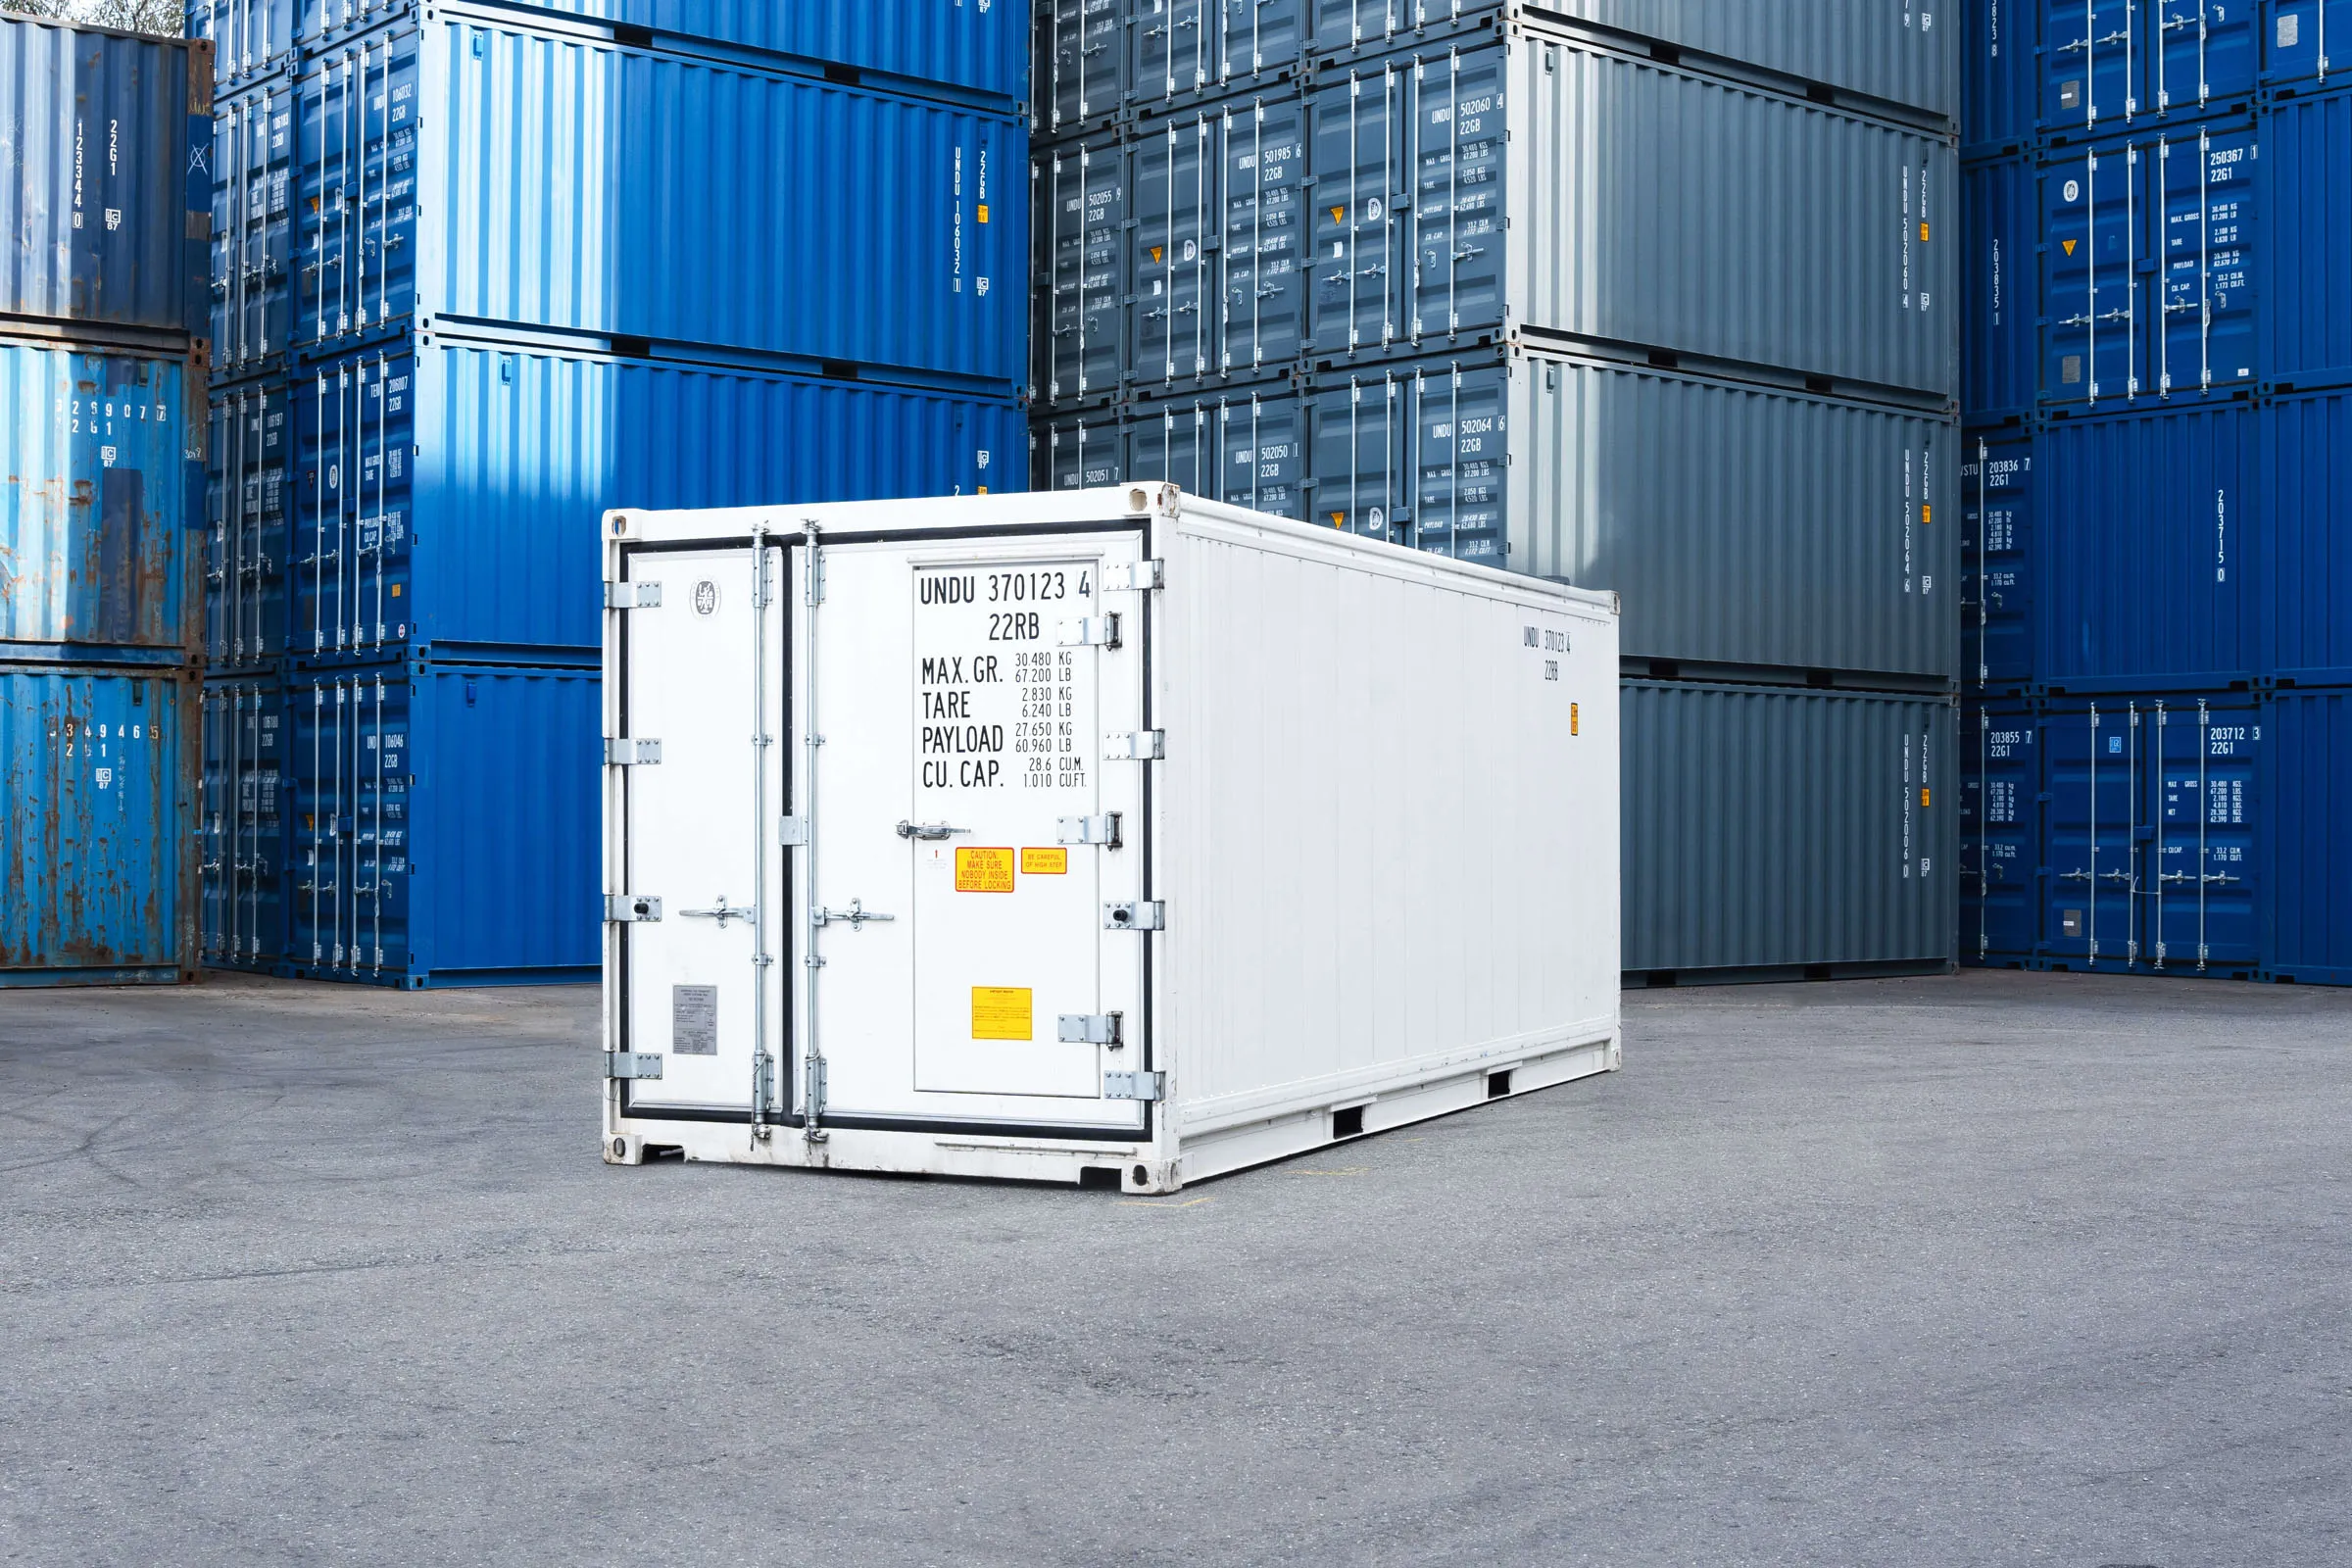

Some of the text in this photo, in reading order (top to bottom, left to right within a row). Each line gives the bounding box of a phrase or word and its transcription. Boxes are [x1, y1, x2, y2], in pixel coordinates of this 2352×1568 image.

[1432, 107, 1450, 123] UNDU
[1460, 97, 1491, 117] 502060
[1459, 119, 1481, 135] 22GB
[1239, 155, 1255, 171] UNDU
[1264, 146, 1291, 165] 501985
[2210, 148, 2243, 166] 250367
[1264, 166, 1283, 181] 22GB
[2211, 167, 2232, 182] 22G1
[1089, 190, 1112, 206] 502055
[1088, 208, 1104, 222] 22GB
[107, 222, 118, 231] 87
[2173, 260, 2194, 270] PAYLOAD
[1433, 416, 1505, 439] UNDU 502064 6
[1460, 438, 1482, 453] 22GB
[1235, 450, 1252, 464] UNDU
[1261, 445, 1288, 460] 502050
[1260, 464, 1279, 477] 22GB
[1988, 460, 2019, 473] 203836
[1086, 468, 1108, 483] 502051
[1989, 473, 2009, 486] 22G1
[920, 570, 1091, 605] UNDU 370123 4
[989, 612, 1040, 640] 22RB
[1524, 626, 1540, 649] UNDU
[1544, 629, 1565, 653] 370123
[1015, 652, 1072, 666] 30.480 KG
[1015, 668, 1072, 682] 67.200 LB
[1022, 687, 1072, 702] 2.830 KG
[922, 691, 971, 718] TARE
[1022, 703, 1072, 717] 6.240 LB
[1015, 722, 1072, 737] 27.650 KG
[2210, 727, 2245, 740] 203712
[922, 725, 1004, 754] PAYLOAD
[1990, 731, 2020, 744] 203855
[1015, 738, 1072, 753] 60.960 LB
[1990, 745, 2010, 757] 22G1
[2211, 742, 2233, 755] 22G1
[1029, 758, 1052, 771] 28.6
[922, 760, 1004, 788] CU. CAP.
[1023, 774, 1053, 788] 1.010
[966, 860, 1003, 869] MAKE SURE
[960, 870, 1008, 880] NOBODY INSIDE
[958, 880, 1011, 890] BEFORE LOCKING
